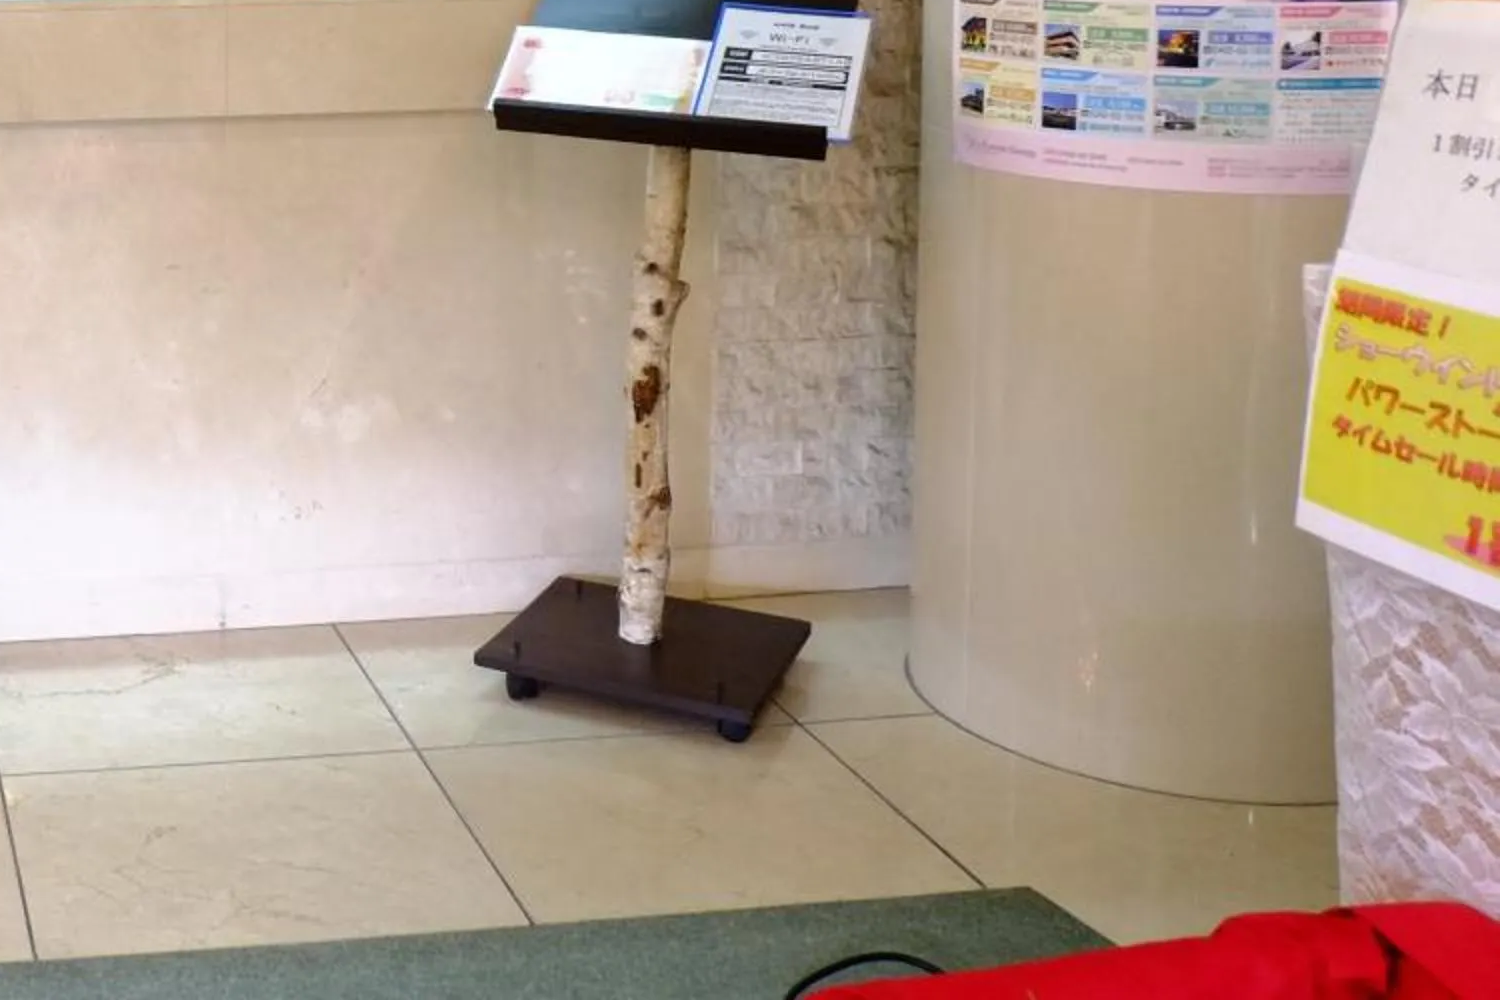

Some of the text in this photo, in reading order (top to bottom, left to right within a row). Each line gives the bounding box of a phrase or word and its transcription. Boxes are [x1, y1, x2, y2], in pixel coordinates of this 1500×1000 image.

[1422, 68, 1479, 101] 本日
[1434, 132, 1500, 161] 1割引
[1345, 375, 1500, 440] パワーストー
